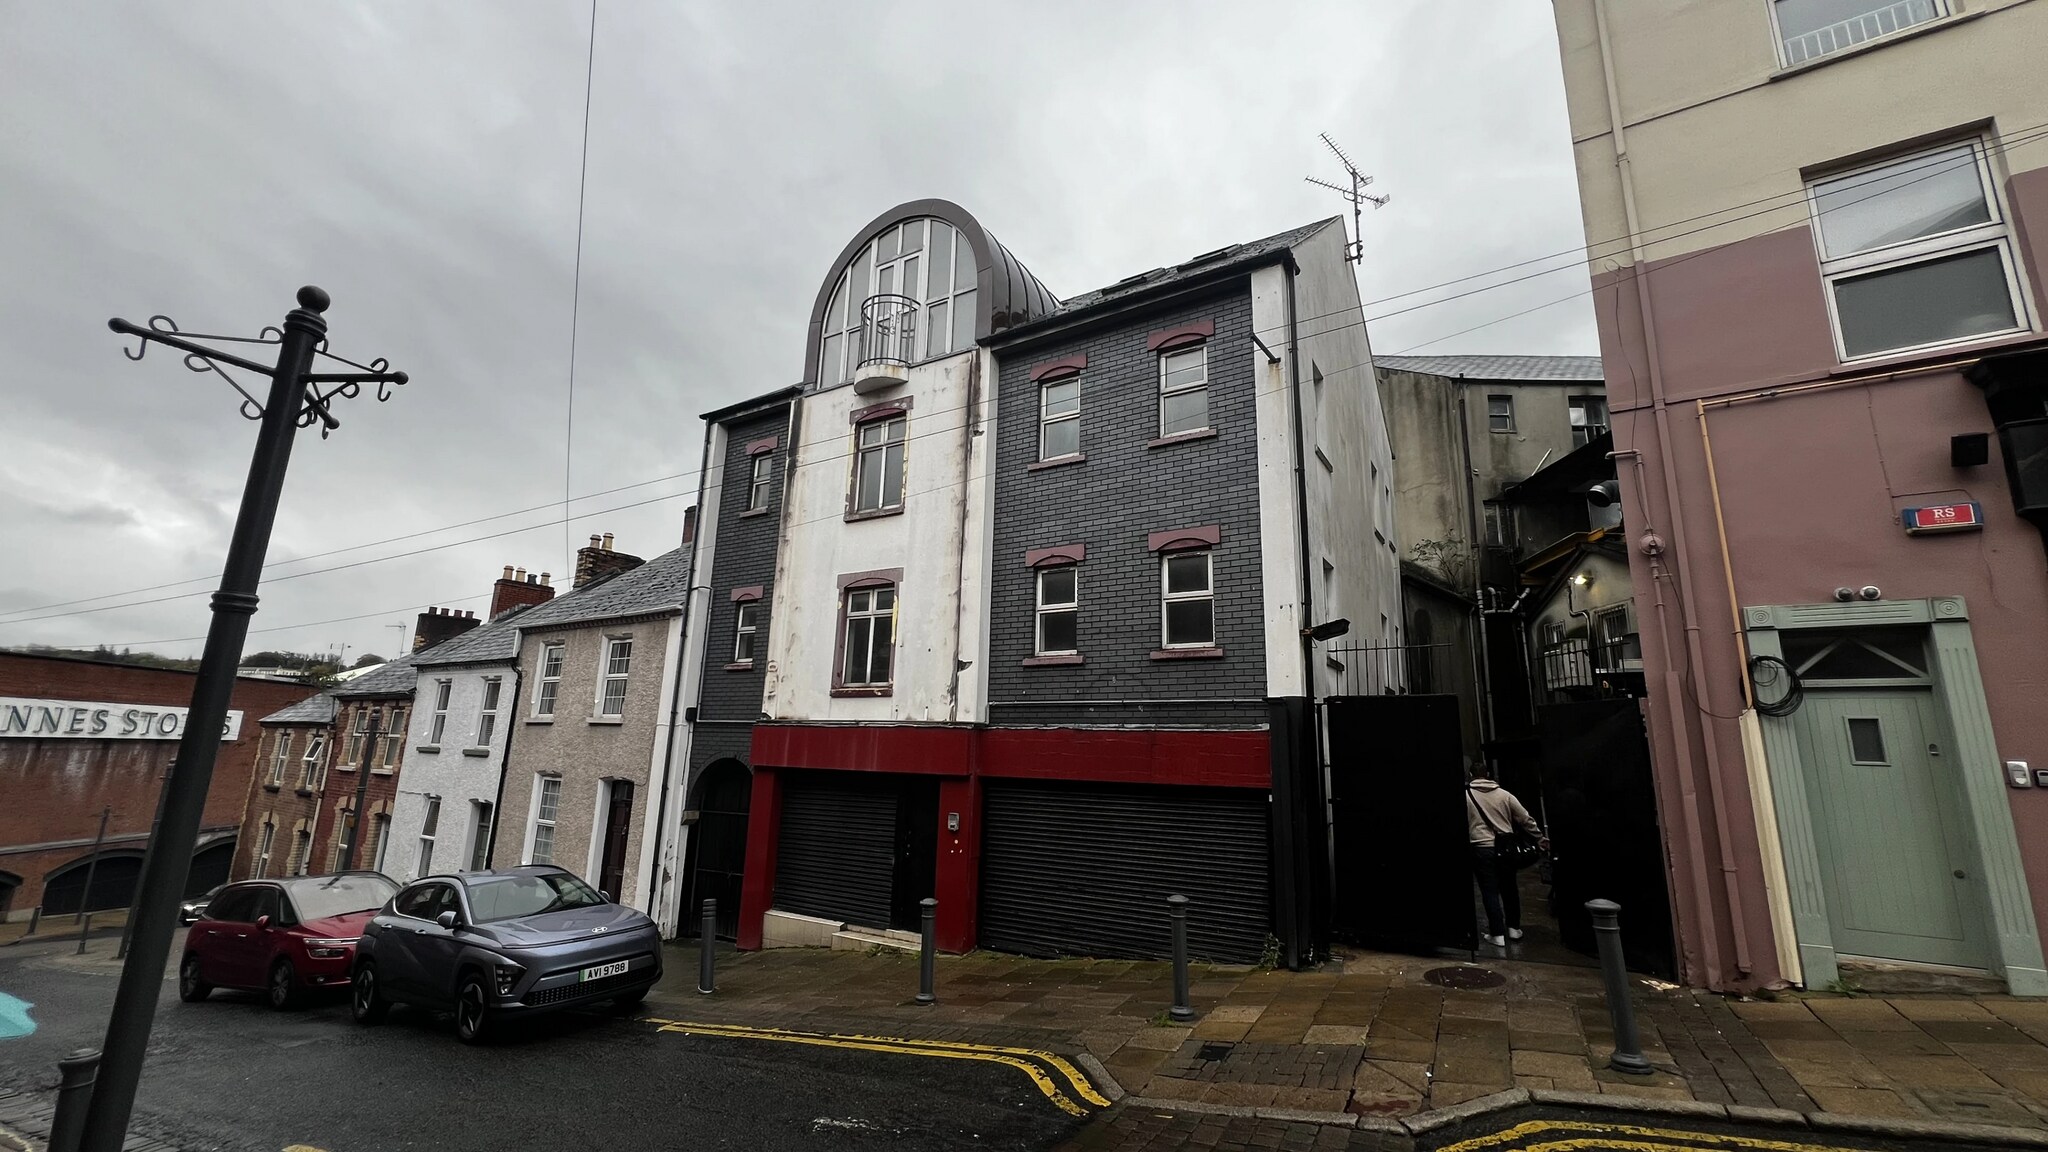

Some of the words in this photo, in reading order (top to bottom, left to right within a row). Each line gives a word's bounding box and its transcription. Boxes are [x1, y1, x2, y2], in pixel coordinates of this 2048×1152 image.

[1932, 507, 1955, 518] RS
[121, 709, 232, 736] STOS
[587, 967, 601, 979] AVI
[603, 962, 626, 976] 9788
